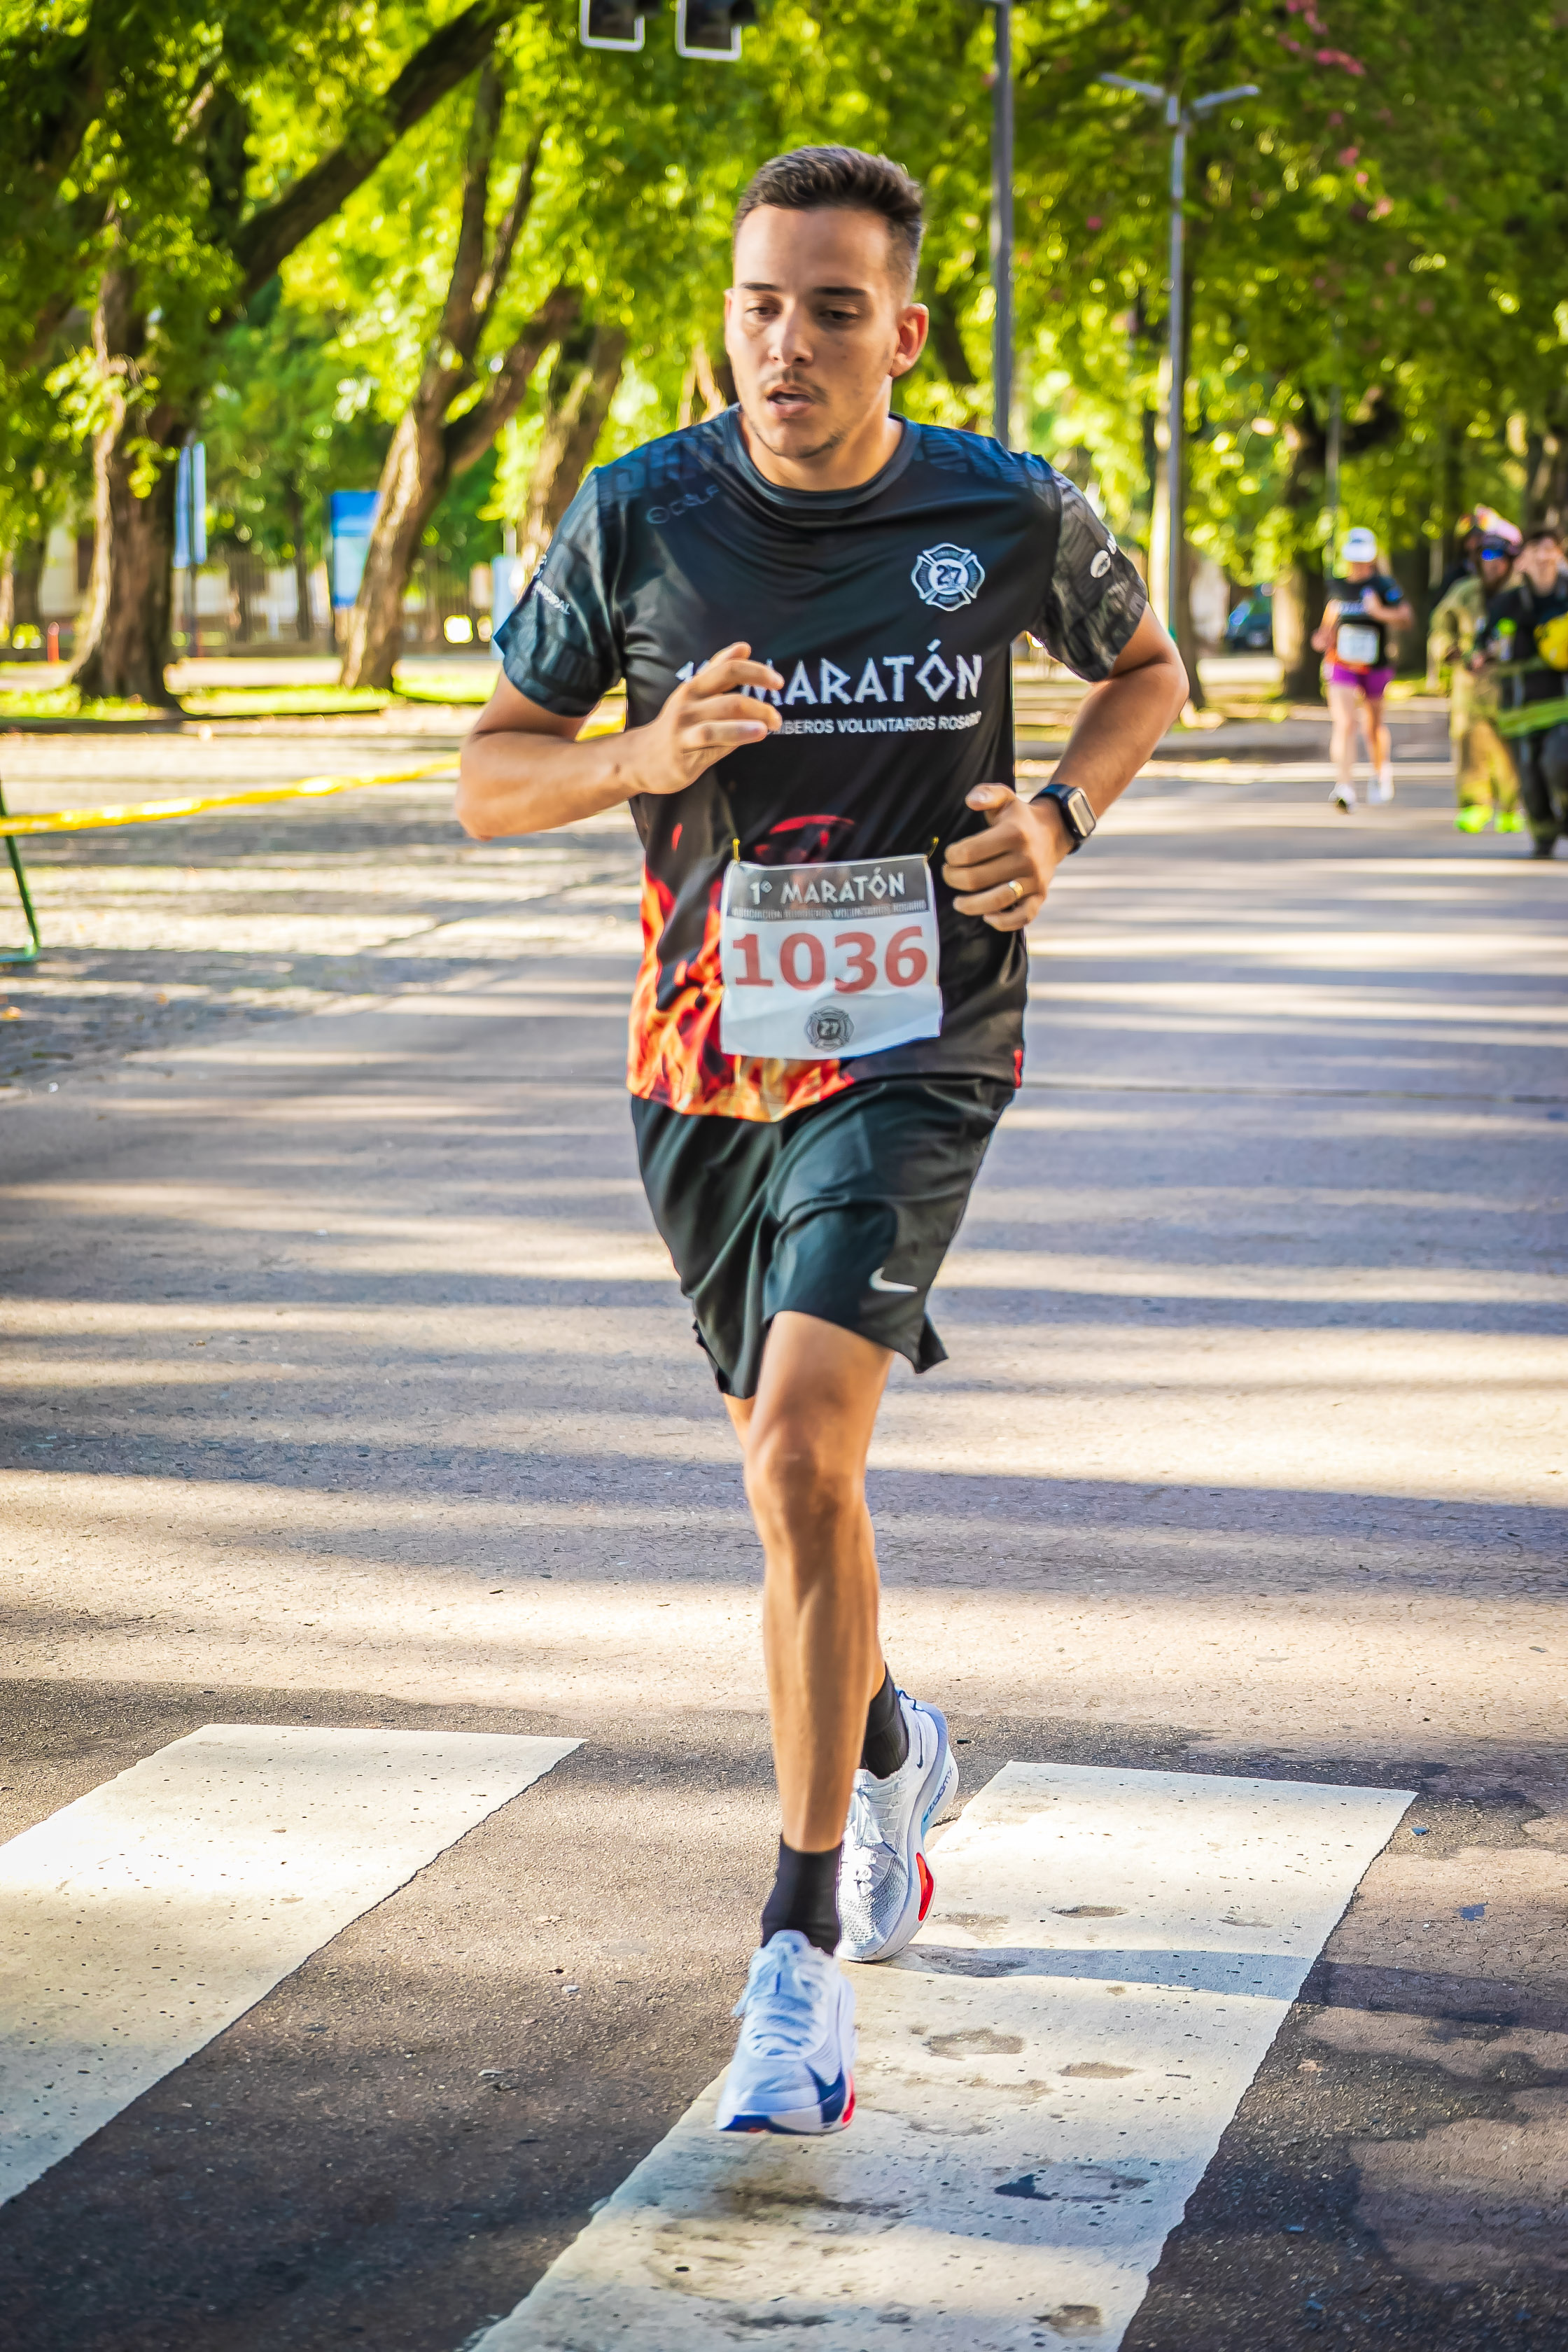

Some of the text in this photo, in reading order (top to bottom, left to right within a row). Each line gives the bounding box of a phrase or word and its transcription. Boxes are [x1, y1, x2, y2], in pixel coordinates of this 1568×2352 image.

[936, 564, 962, 587] 27
[836, 715, 936, 734] VOLUNTARIOS
[780, 867, 906, 904] MARATÓN
[732, 925, 929, 994] 1036
